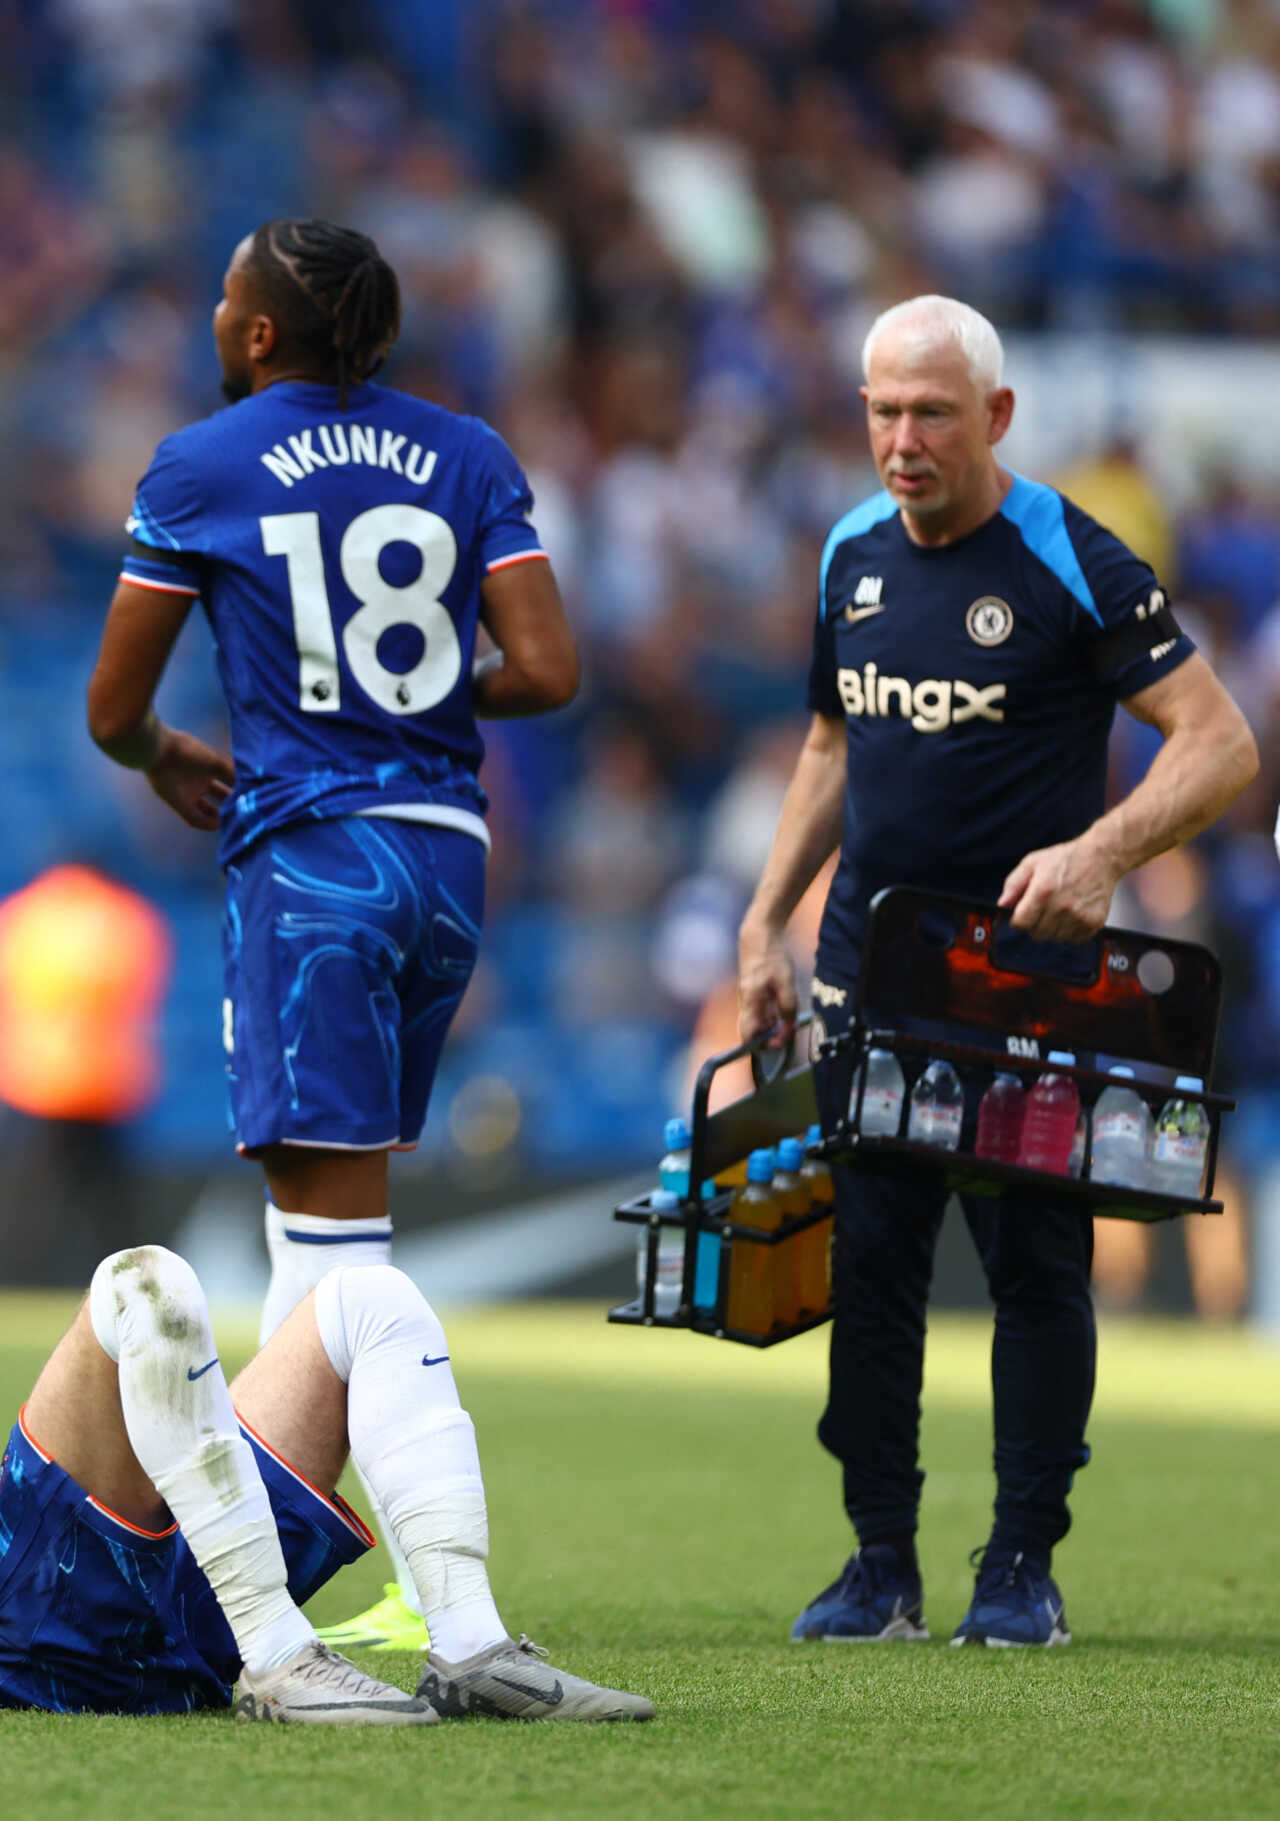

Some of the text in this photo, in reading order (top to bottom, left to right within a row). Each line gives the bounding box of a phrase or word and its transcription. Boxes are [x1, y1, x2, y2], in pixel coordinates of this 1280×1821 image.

[261, 424, 438, 488] NKUNKU
[260, 504, 461, 716] 18
[837, 662, 1006, 733] Bingx
